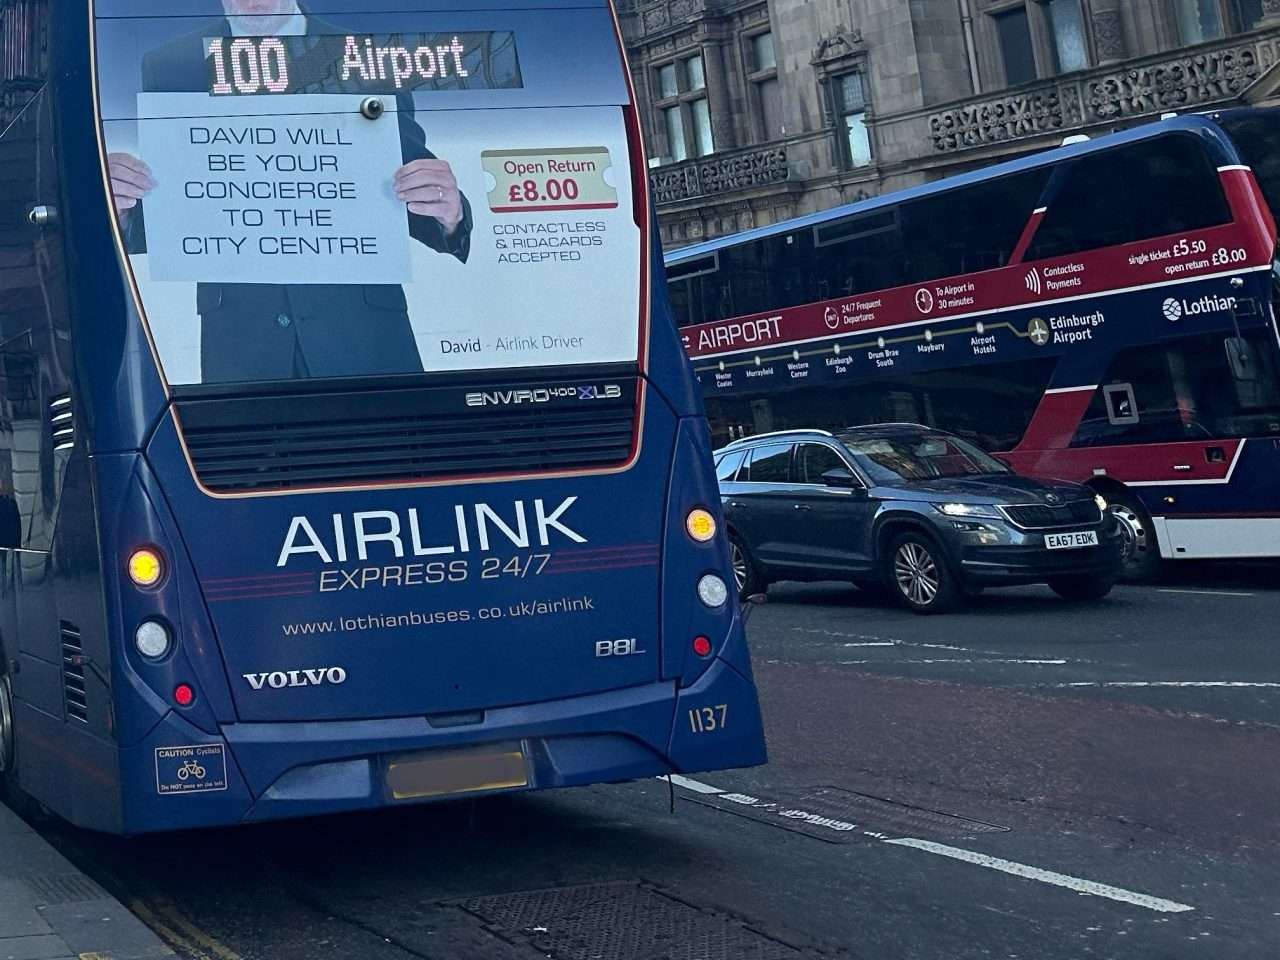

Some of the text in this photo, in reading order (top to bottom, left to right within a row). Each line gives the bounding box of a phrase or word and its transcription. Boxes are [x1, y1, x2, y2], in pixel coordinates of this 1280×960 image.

[208, 36, 469, 94] 100 Airport
[189, 127, 353, 146] DAVID WILL
[208, 154, 338, 172] BE YOUR
[503, 159, 596, 176] Open Return
[184, 181, 357, 200] CONCIERGE
[509, 178, 579, 202] £8.00
[222, 208, 333, 227] TO THE
[493, 221, 606, 235] CONTACTLESS
[182, 236, 379, 255] CITY CENTRE
[495, 236, 603, 249] & RIDACARDS
[1128, 239, 1207, 265] single ticket £5.50
[498, 250, 581, 263] ACCEPTED
[1165, 247, 1247, 275] open return £8.00
[1043, 262, 1085, 277] Contactless
[935, 282, 975, 297] To Airport in
[1046, 277, 1081, 291] Payments
[841, 299, 882, 314] 24/7 Frequent
[938, 296, 975, 310] 30 minutes
[1049, 310, 1105, 329] Edinburgh
[698, 316, 783, 351] AIRPORT
[1053, 328, 1093, 344] Airport
[440, 338, 482, 354] David
[495, 336, 539, 352] Airlink
[542, 335, 584, 350] Driver
[276, 496, 589, 567] AIRLINK
[1048, 532, 1095, 547] EA67 EDK
[319, 553, 552, 592] EXPRESS 24/7
[282, 595, 595, 637] www.lothianbuses.co.uk/airlink
[595, 638, 647, 657] B8L
[242, 667, 346, 690] VOLVO
[688, 704, 728, 733] 1137
[159, 747, 221, 758] CAUTION Cyclists
